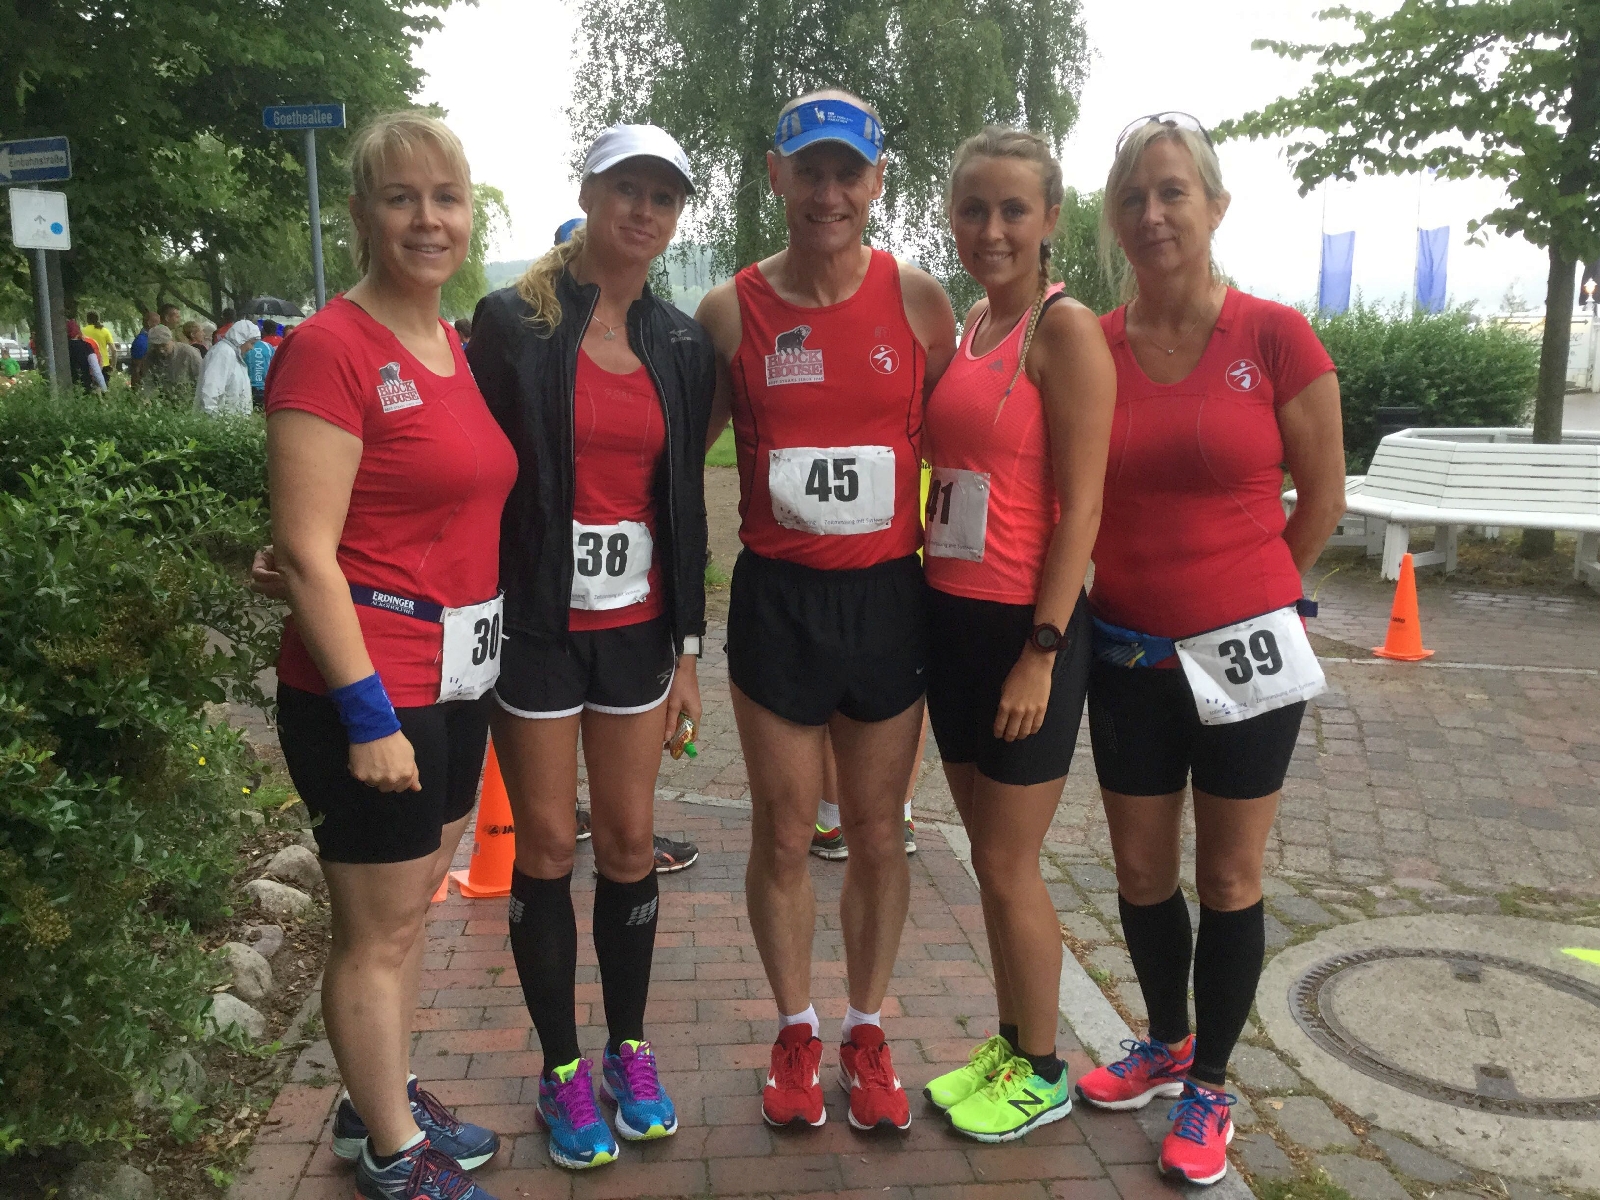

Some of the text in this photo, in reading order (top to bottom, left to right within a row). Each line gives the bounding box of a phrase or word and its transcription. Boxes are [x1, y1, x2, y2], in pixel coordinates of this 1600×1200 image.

[273, 109, 333, 126] Goetheallee
[767, 350, 822, 368] BLOCK
[767, 363, 823, 379] HOUSE
[377, 380, 416, 397] BLOCK
[381, 391, 420, 406] HOUSE
[805, 457, 859, 503] 45
[577, 531, 630, 577] 38
[372, 591, 415, 611] ERDINGER
[471, 612, 500, 666] 30
[1217, 629, 1284, 685] 39
[502, 824, 514, 834] JA
